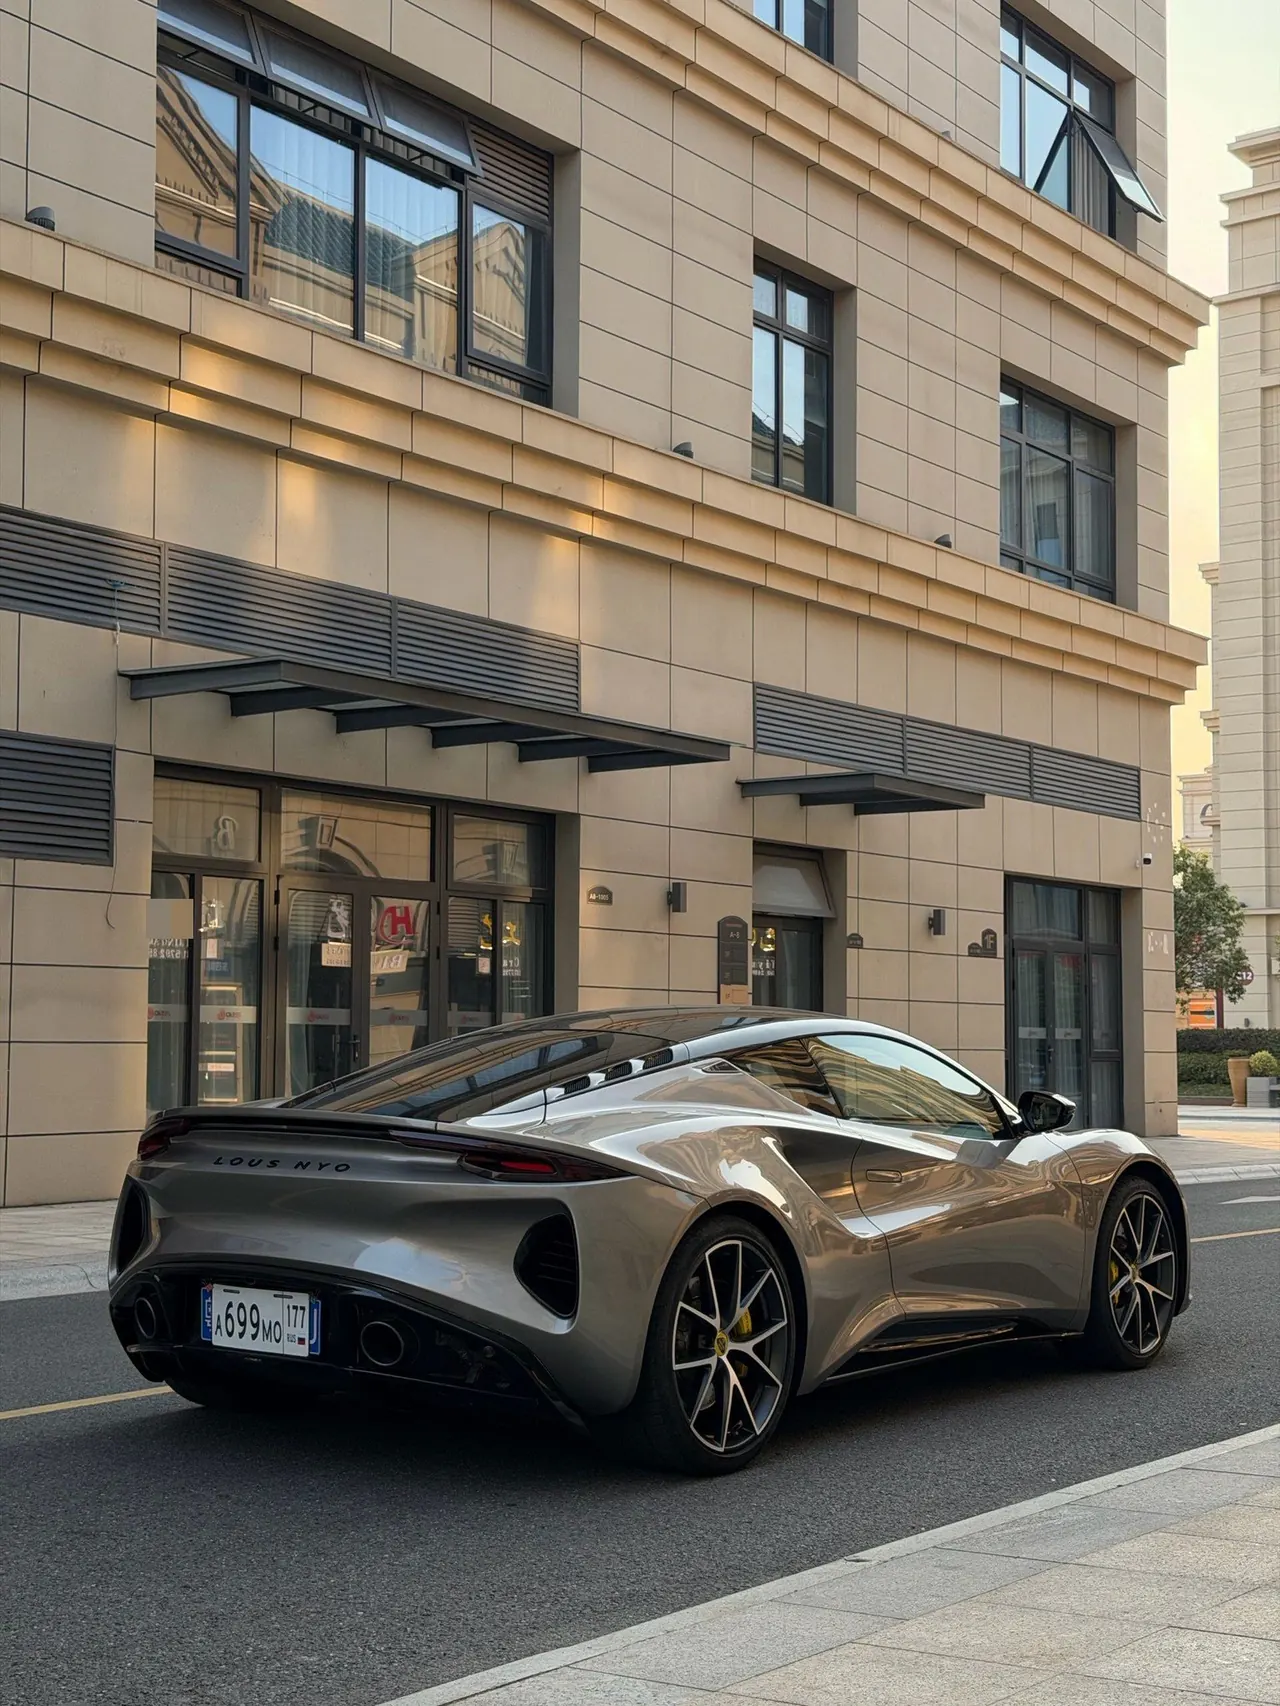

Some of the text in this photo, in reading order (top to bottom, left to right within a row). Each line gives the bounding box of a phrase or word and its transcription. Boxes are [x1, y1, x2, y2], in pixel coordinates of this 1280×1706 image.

[213, 1156, 351, 1173] LOUS NYO
[287, 1304, 307, 1329] 177
